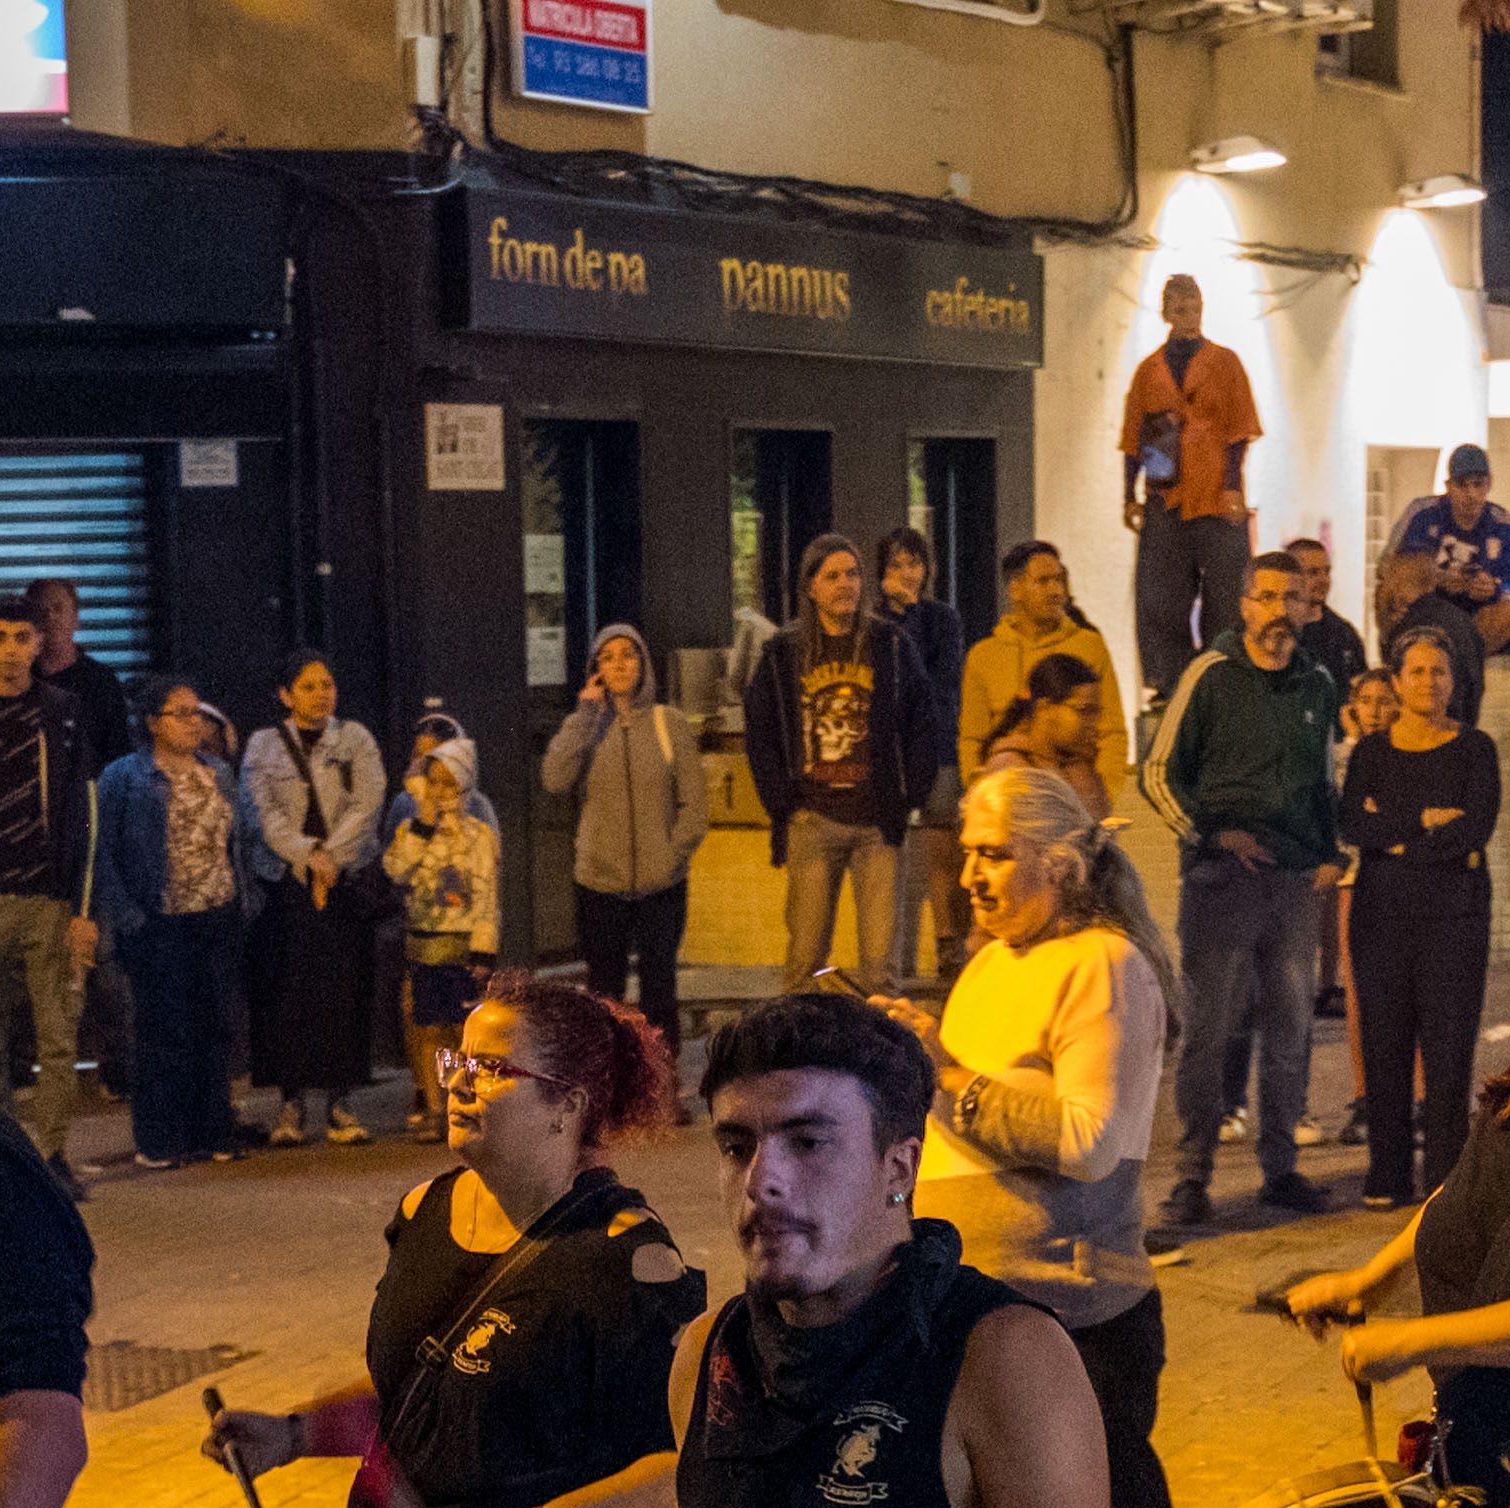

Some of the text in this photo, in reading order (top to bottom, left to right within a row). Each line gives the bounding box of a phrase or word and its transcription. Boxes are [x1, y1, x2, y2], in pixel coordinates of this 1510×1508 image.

[488, 216, 648, 300] forn de pa
[719, 256, 851, 328] pannus
[924, 276, 1031, 336] cafeteria
